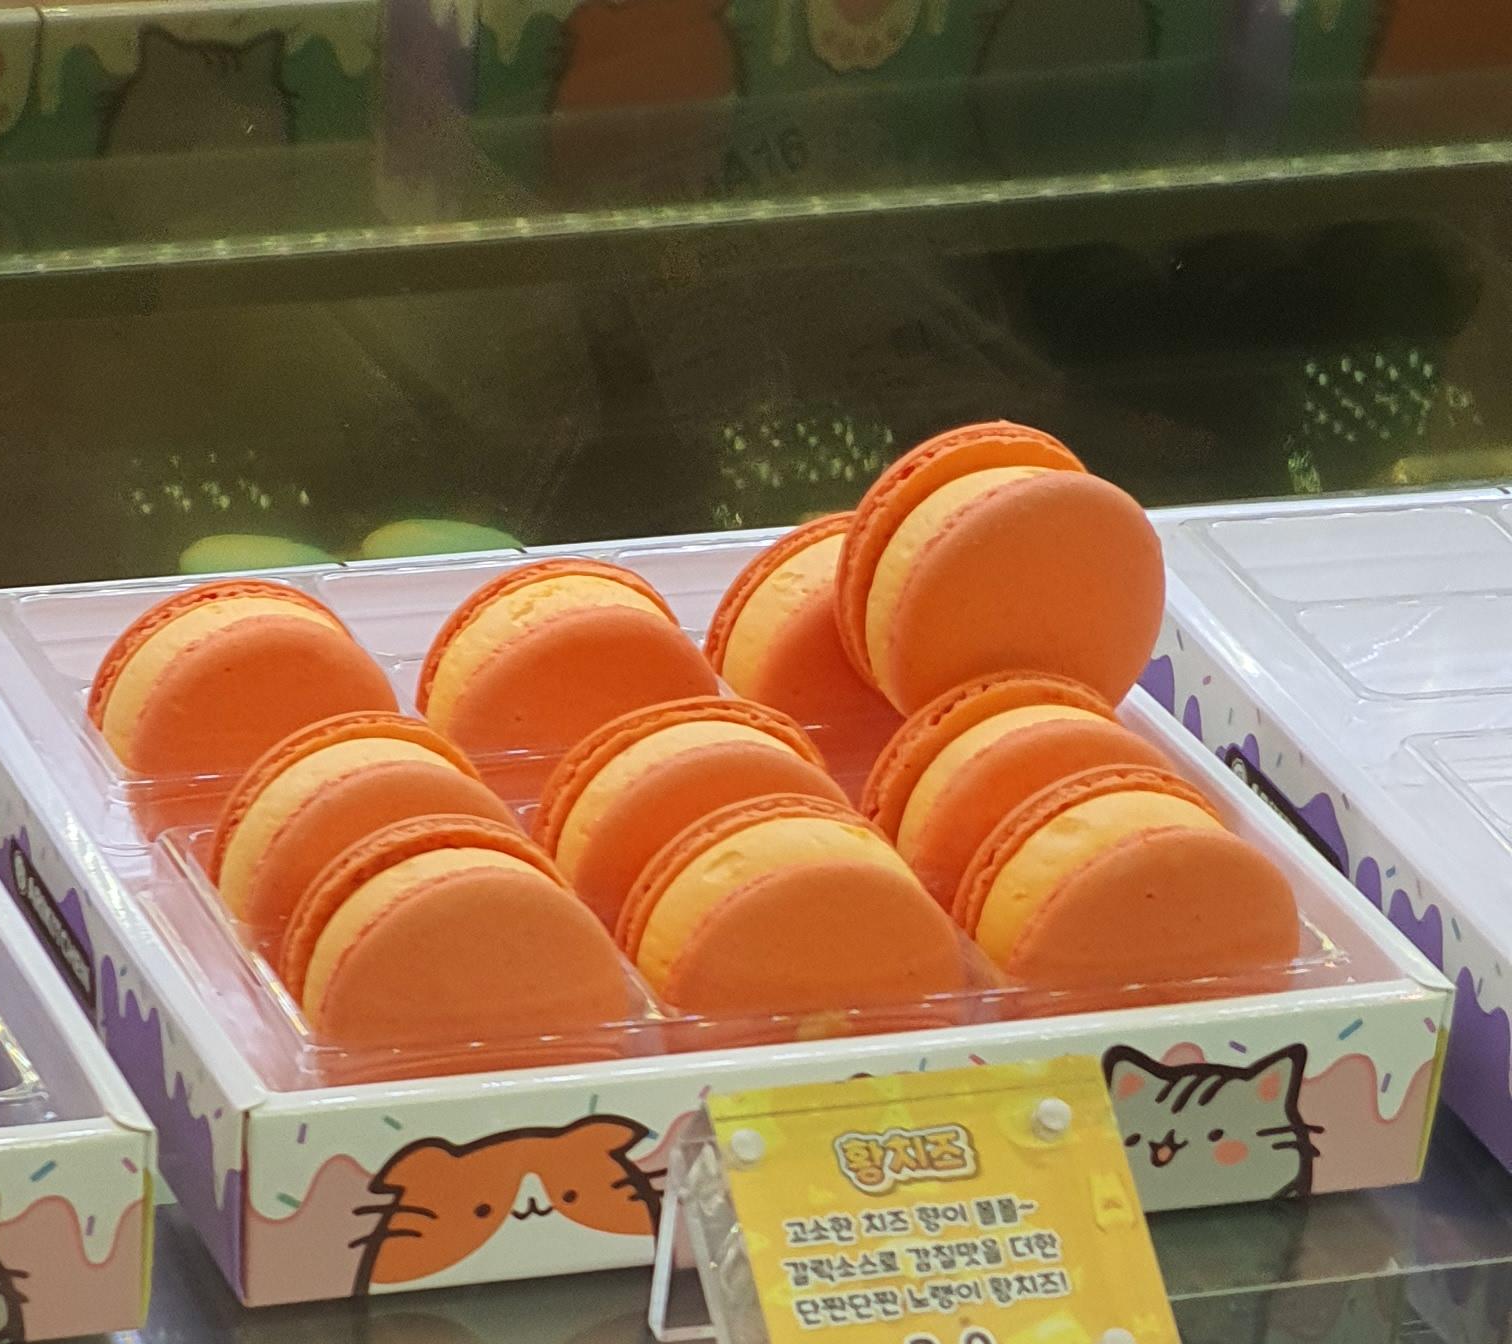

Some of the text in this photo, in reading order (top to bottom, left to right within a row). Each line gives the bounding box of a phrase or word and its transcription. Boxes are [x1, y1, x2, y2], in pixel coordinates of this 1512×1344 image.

[838, 1130, 971, 1187] 황치즈
[784, 1215, 856, 1244] 고소한
[861, 1208, 910, 1235] 치즈
[914, 1203, 970, 1235] 향이
[905, 1237, 1003, 1273] 감칠맛을
[1007, 1231, 1061, 1260] 더한
[794, 1289, 901, 1327] 단짠단짠
[988, 1270, 1070, 1305] 황치즈!
